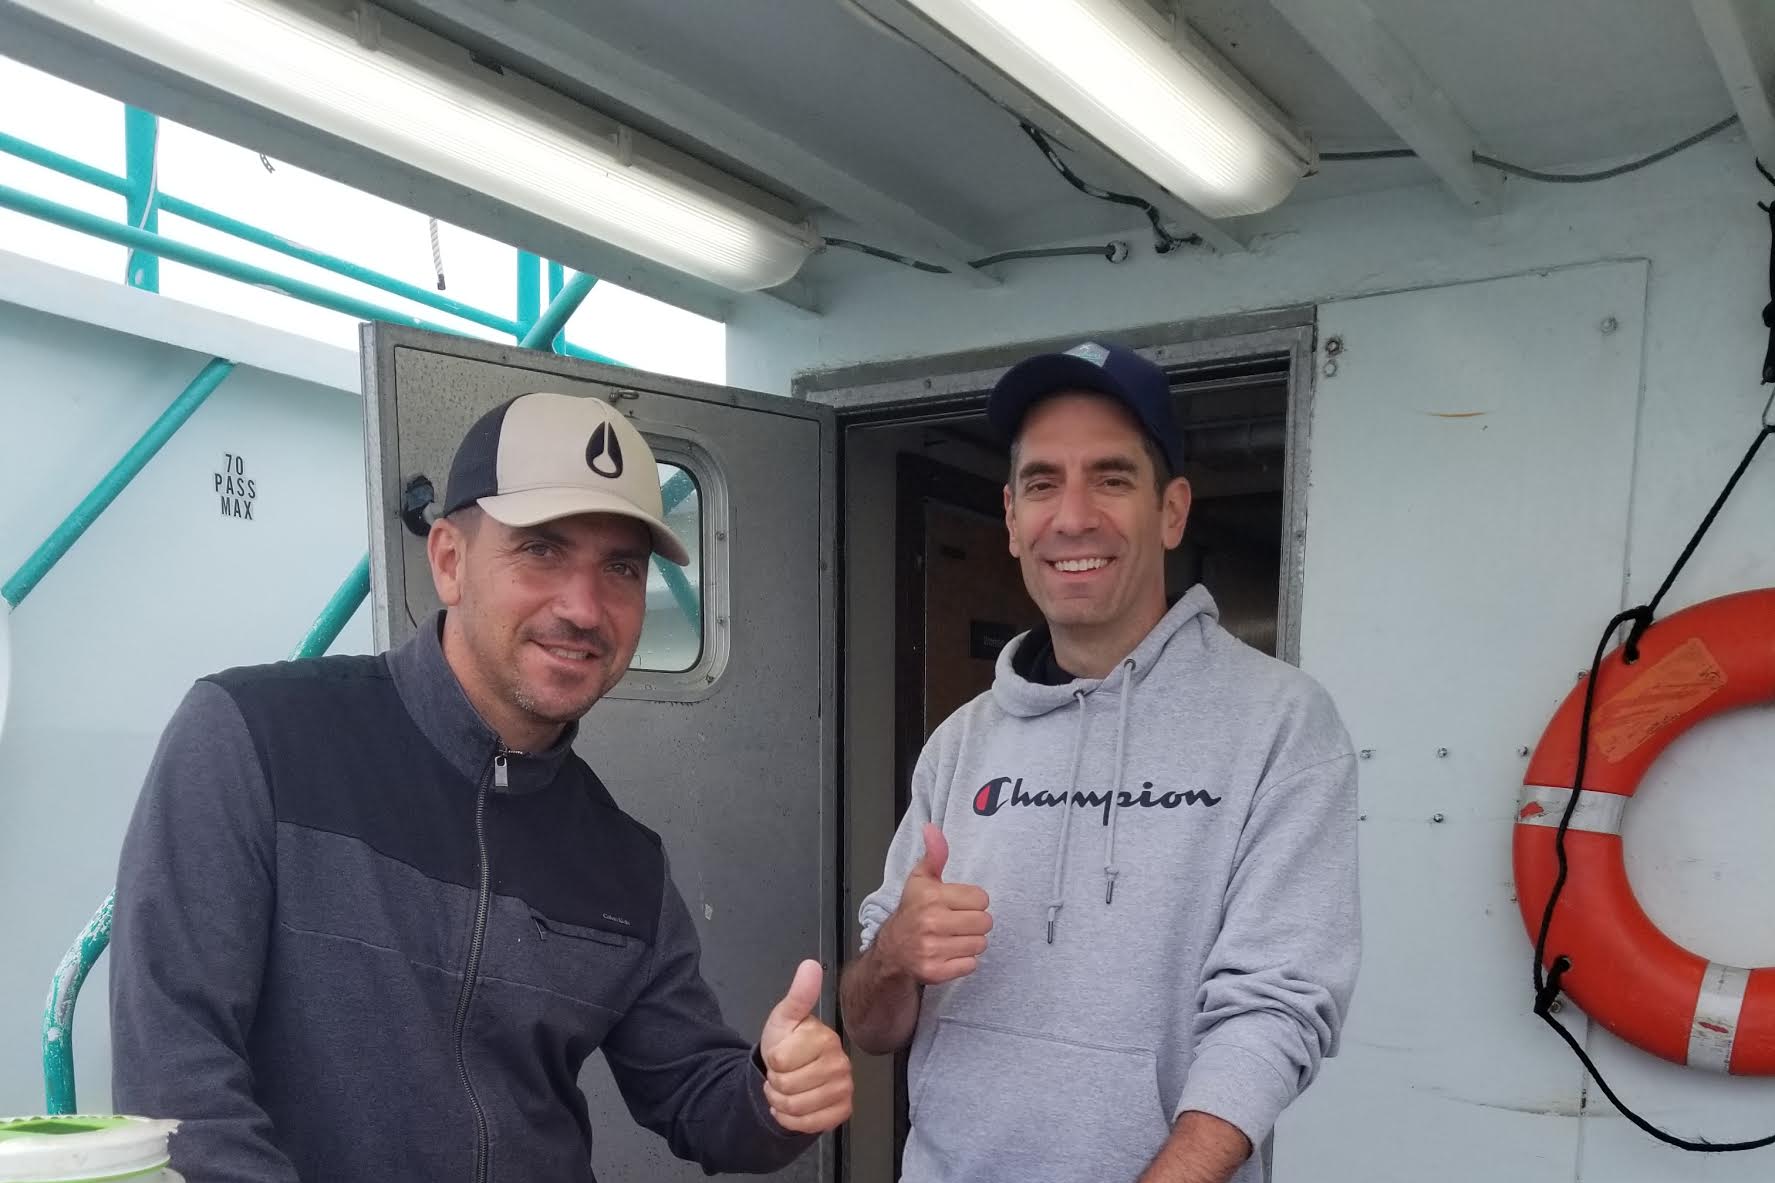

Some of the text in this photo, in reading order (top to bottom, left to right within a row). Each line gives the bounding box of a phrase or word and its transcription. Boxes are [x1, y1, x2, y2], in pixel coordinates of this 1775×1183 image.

[225, 453, 244, 475] 70
[214, 473, 256, 499] PASS
[221, 496, 253, 520] MAX
[973, 777, 1222, 826] Champion
